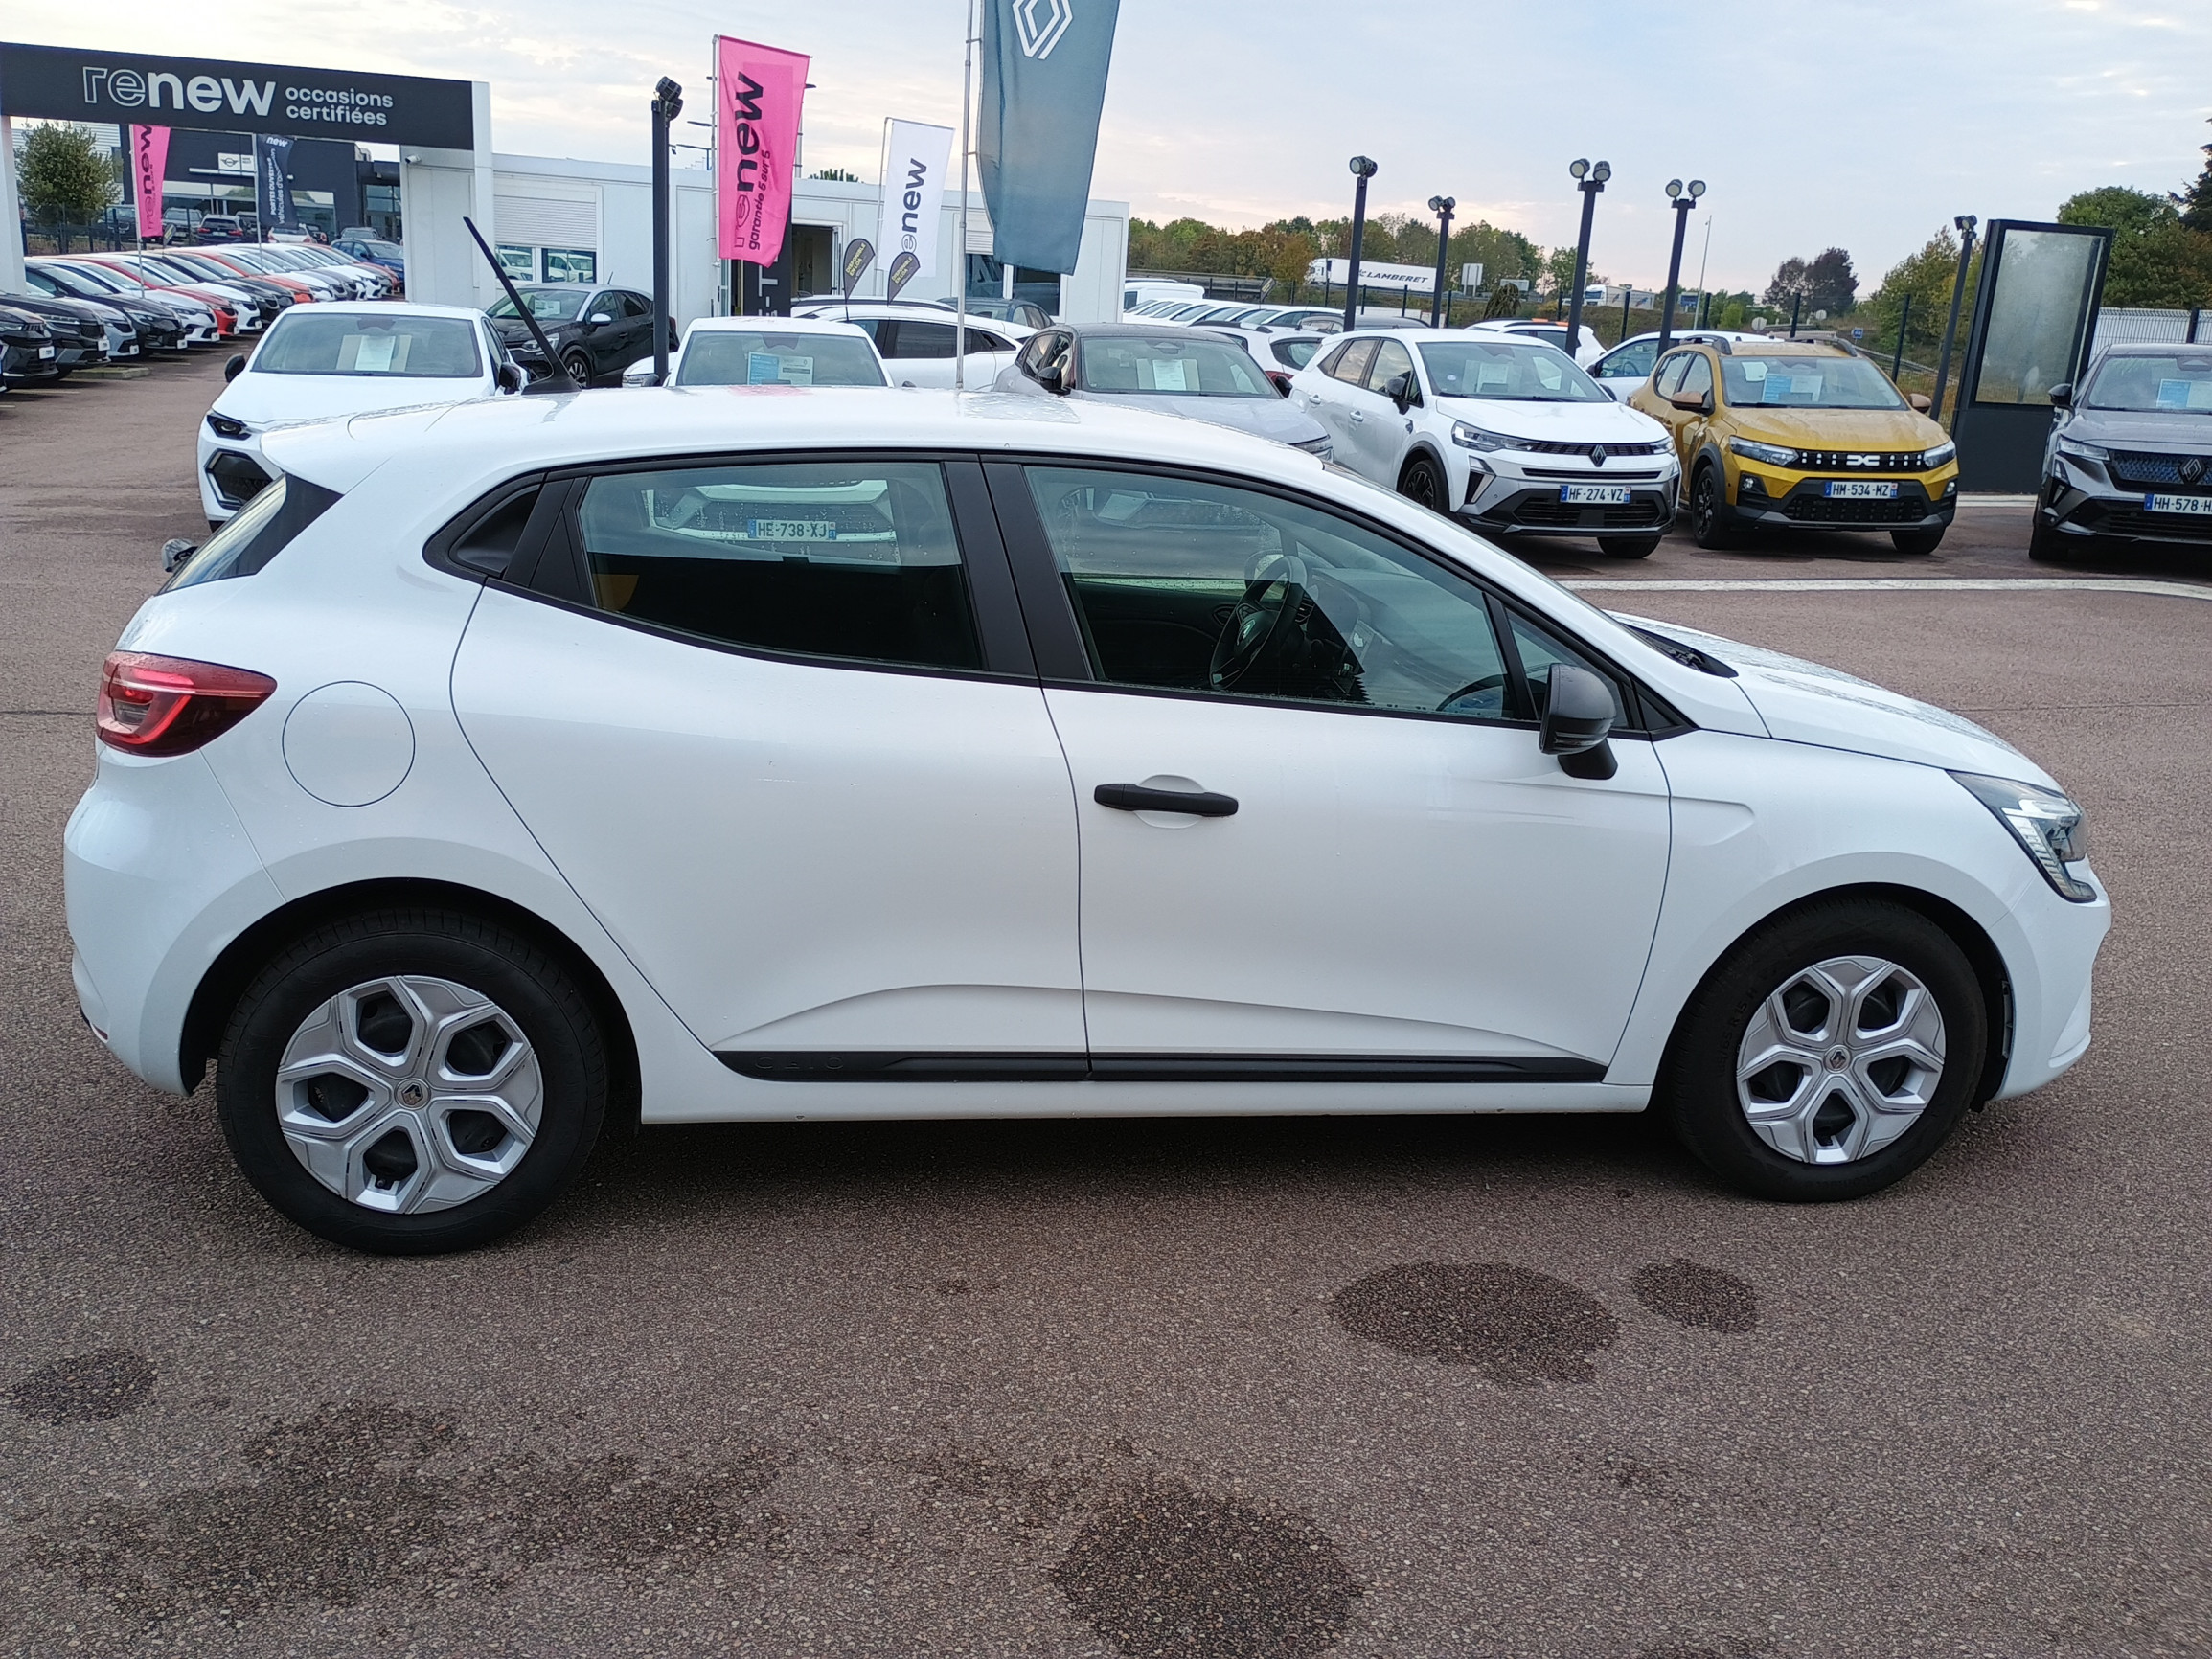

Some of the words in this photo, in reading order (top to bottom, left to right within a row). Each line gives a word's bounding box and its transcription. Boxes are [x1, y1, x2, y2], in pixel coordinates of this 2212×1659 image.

[82, 66, 277, 117] renew
[285, 86, 394, 108] occasions
[285, 103, 388, 126] certifiées
[734, 71, 764, 249] renew
[901, 157, 927, 254] enew
[1366, 271, 1429, 284] LAMBERET
[1568, 487, 1624, 502] HF-274-VZ
[1832, 483, 1890, 496] HM-534-MZ
[2153, 496, 2212, 512] HH-578-H
[757, 522, 828, 538] HE-738-XJ
